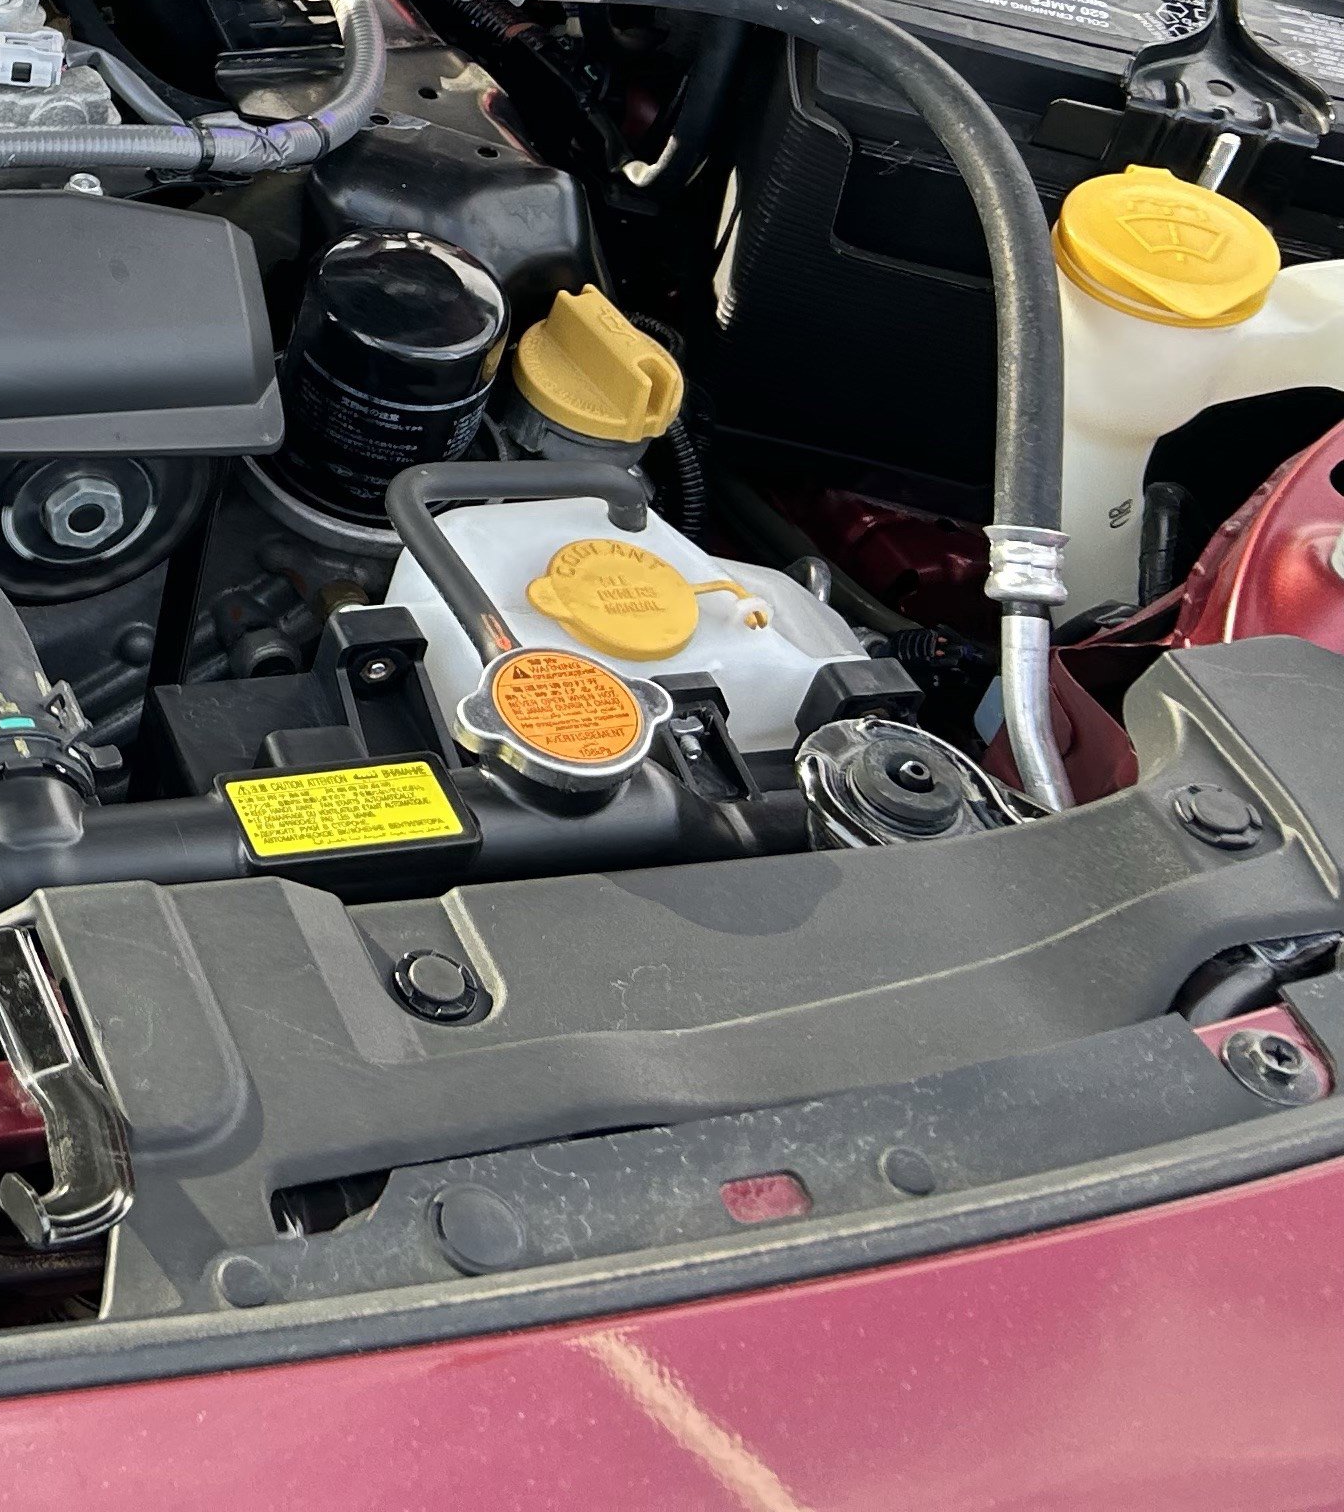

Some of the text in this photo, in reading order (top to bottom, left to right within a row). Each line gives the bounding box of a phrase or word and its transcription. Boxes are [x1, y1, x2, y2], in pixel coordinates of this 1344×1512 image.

[1011, 1, 1074, 21] CRANKING
[1080, 6, 1110, 19] 620
[1076, 15, 1110, 28] COLD
[269, 779, 304, 791] CAUTION
[305, 774, 348, 786] ATTENTION
